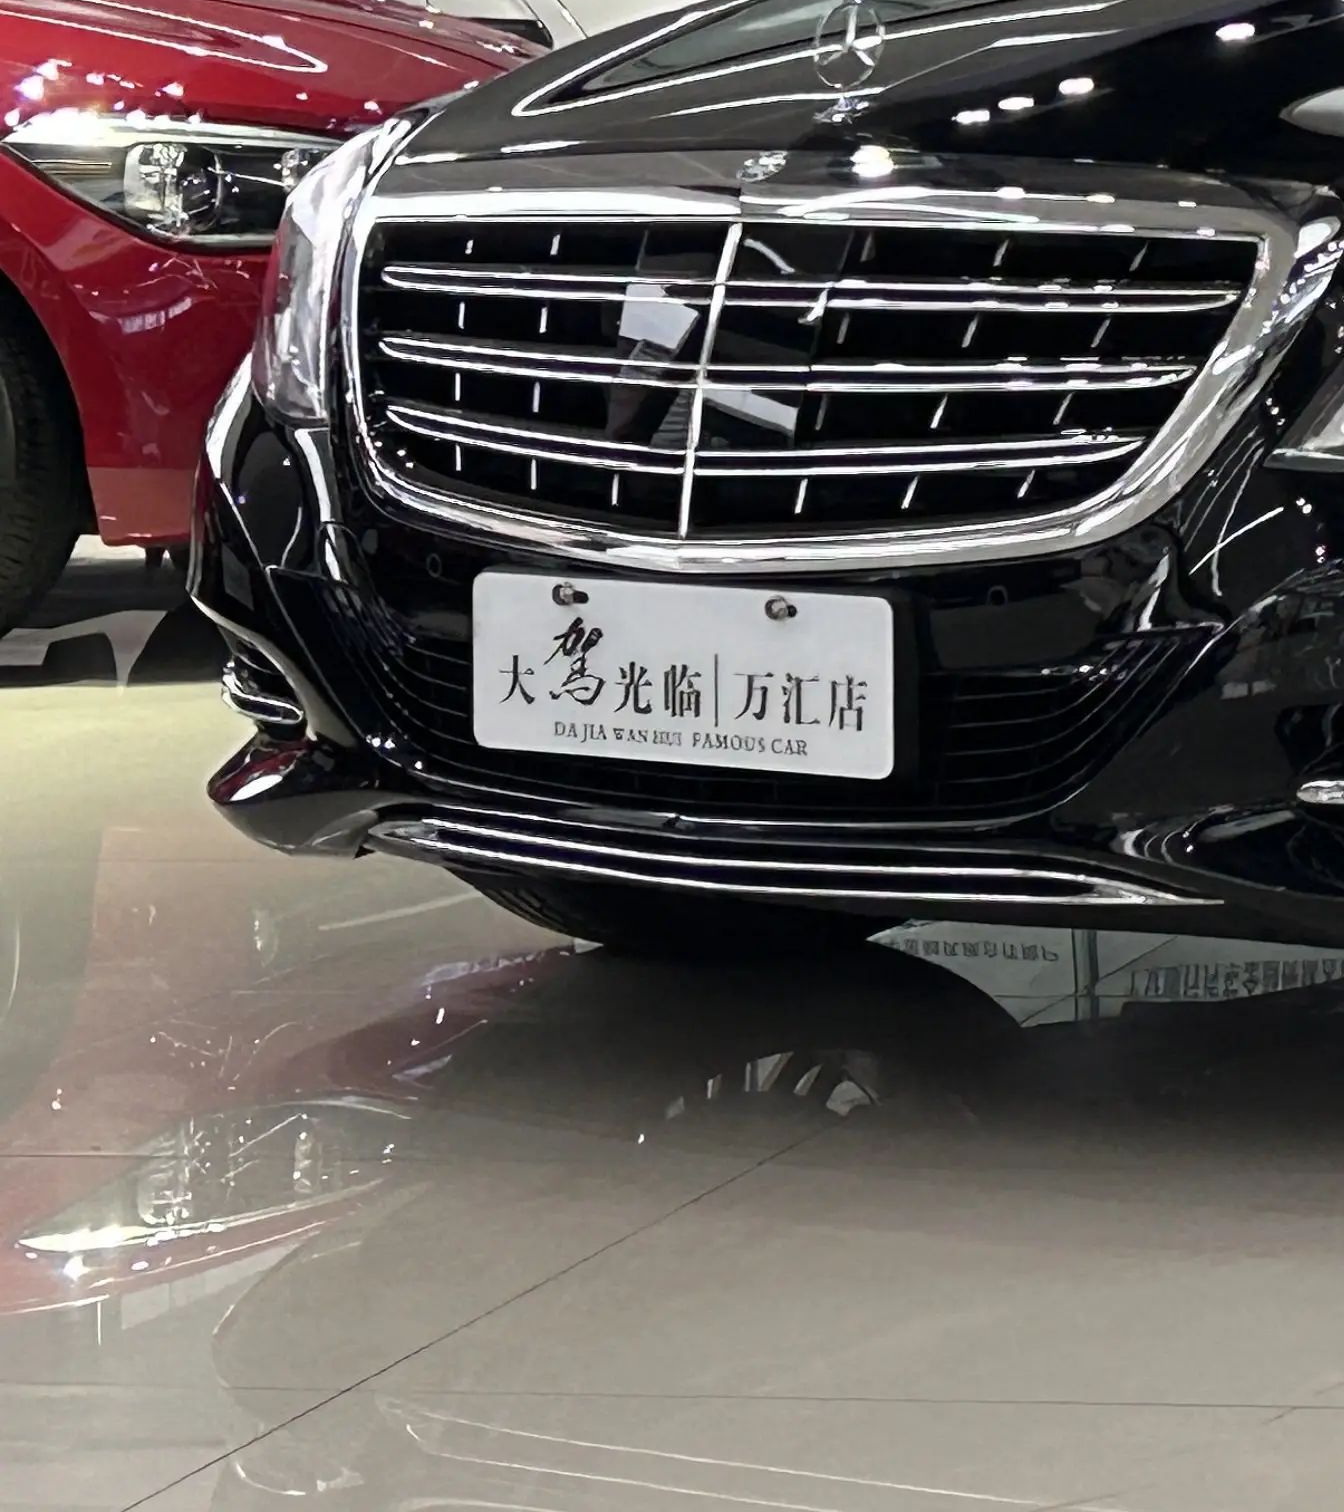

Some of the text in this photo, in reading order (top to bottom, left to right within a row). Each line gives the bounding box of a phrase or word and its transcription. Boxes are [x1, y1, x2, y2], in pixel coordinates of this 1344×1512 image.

[553, 721, 579, 738] DA
[579, 723, 608, 744] JIA
[692, 733, 767, 755] FAMOUS
[771, 738, 809, 756] CAR
